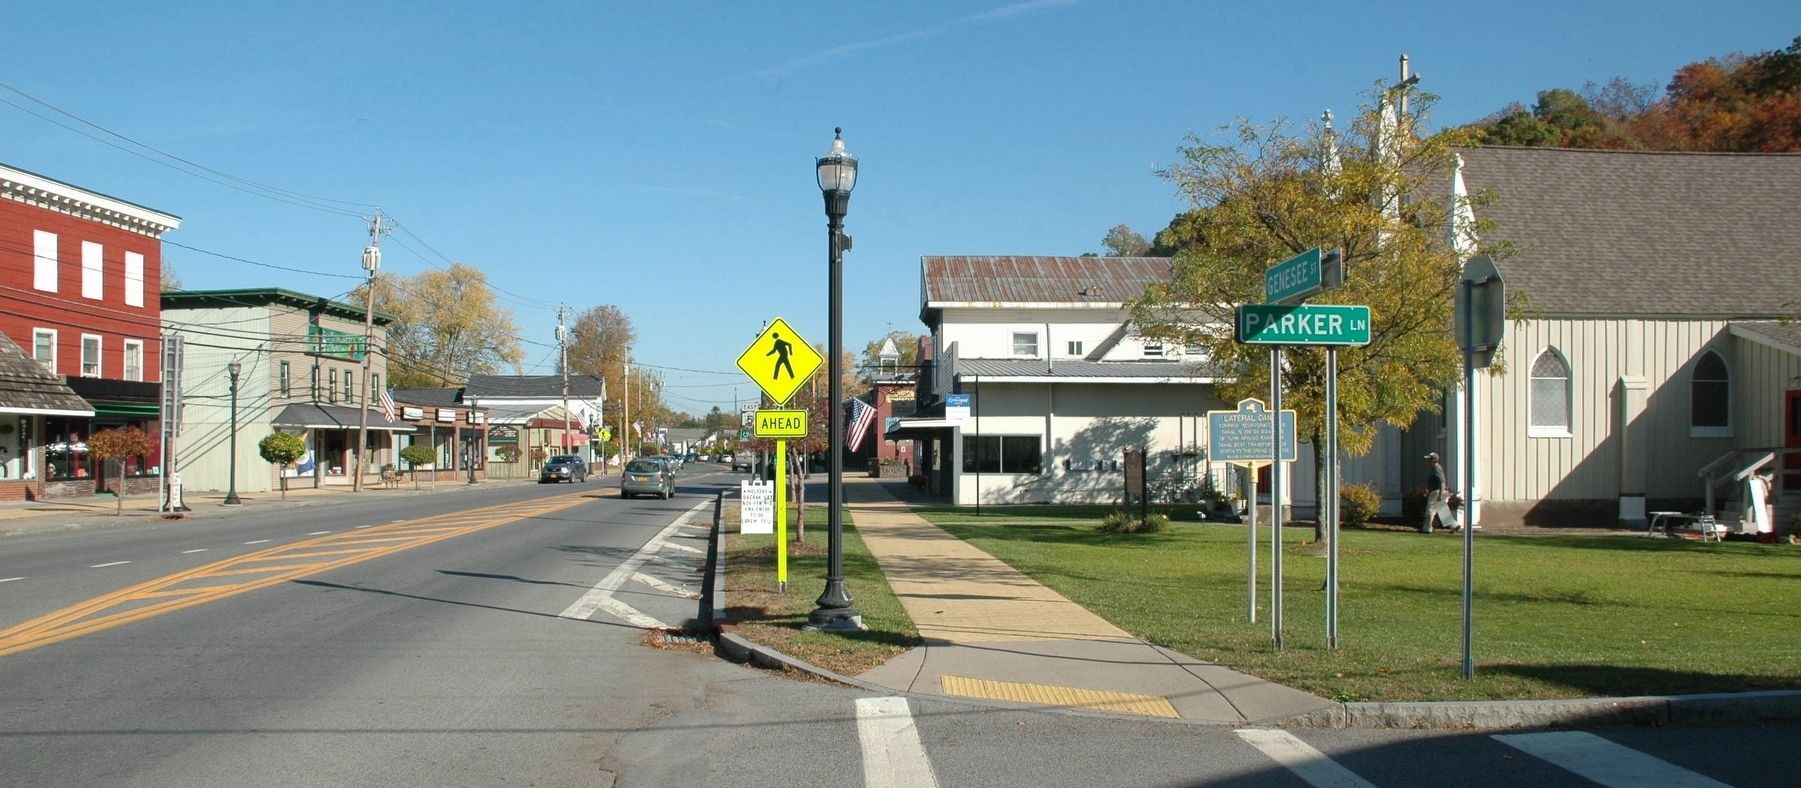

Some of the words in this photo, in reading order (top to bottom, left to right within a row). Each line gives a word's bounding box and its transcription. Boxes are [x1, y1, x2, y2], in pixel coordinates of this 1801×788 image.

[1268, 261, 1308, 295] GENESEE
[1310, 262, 1317, 274] ST
[1245, 313, 1343, 335] PARKER
[1350, 319, 1366, 330] LN
[761, 417, 801, 429] AHEAD
[1223, 414, 1256, 422] LATERAL
